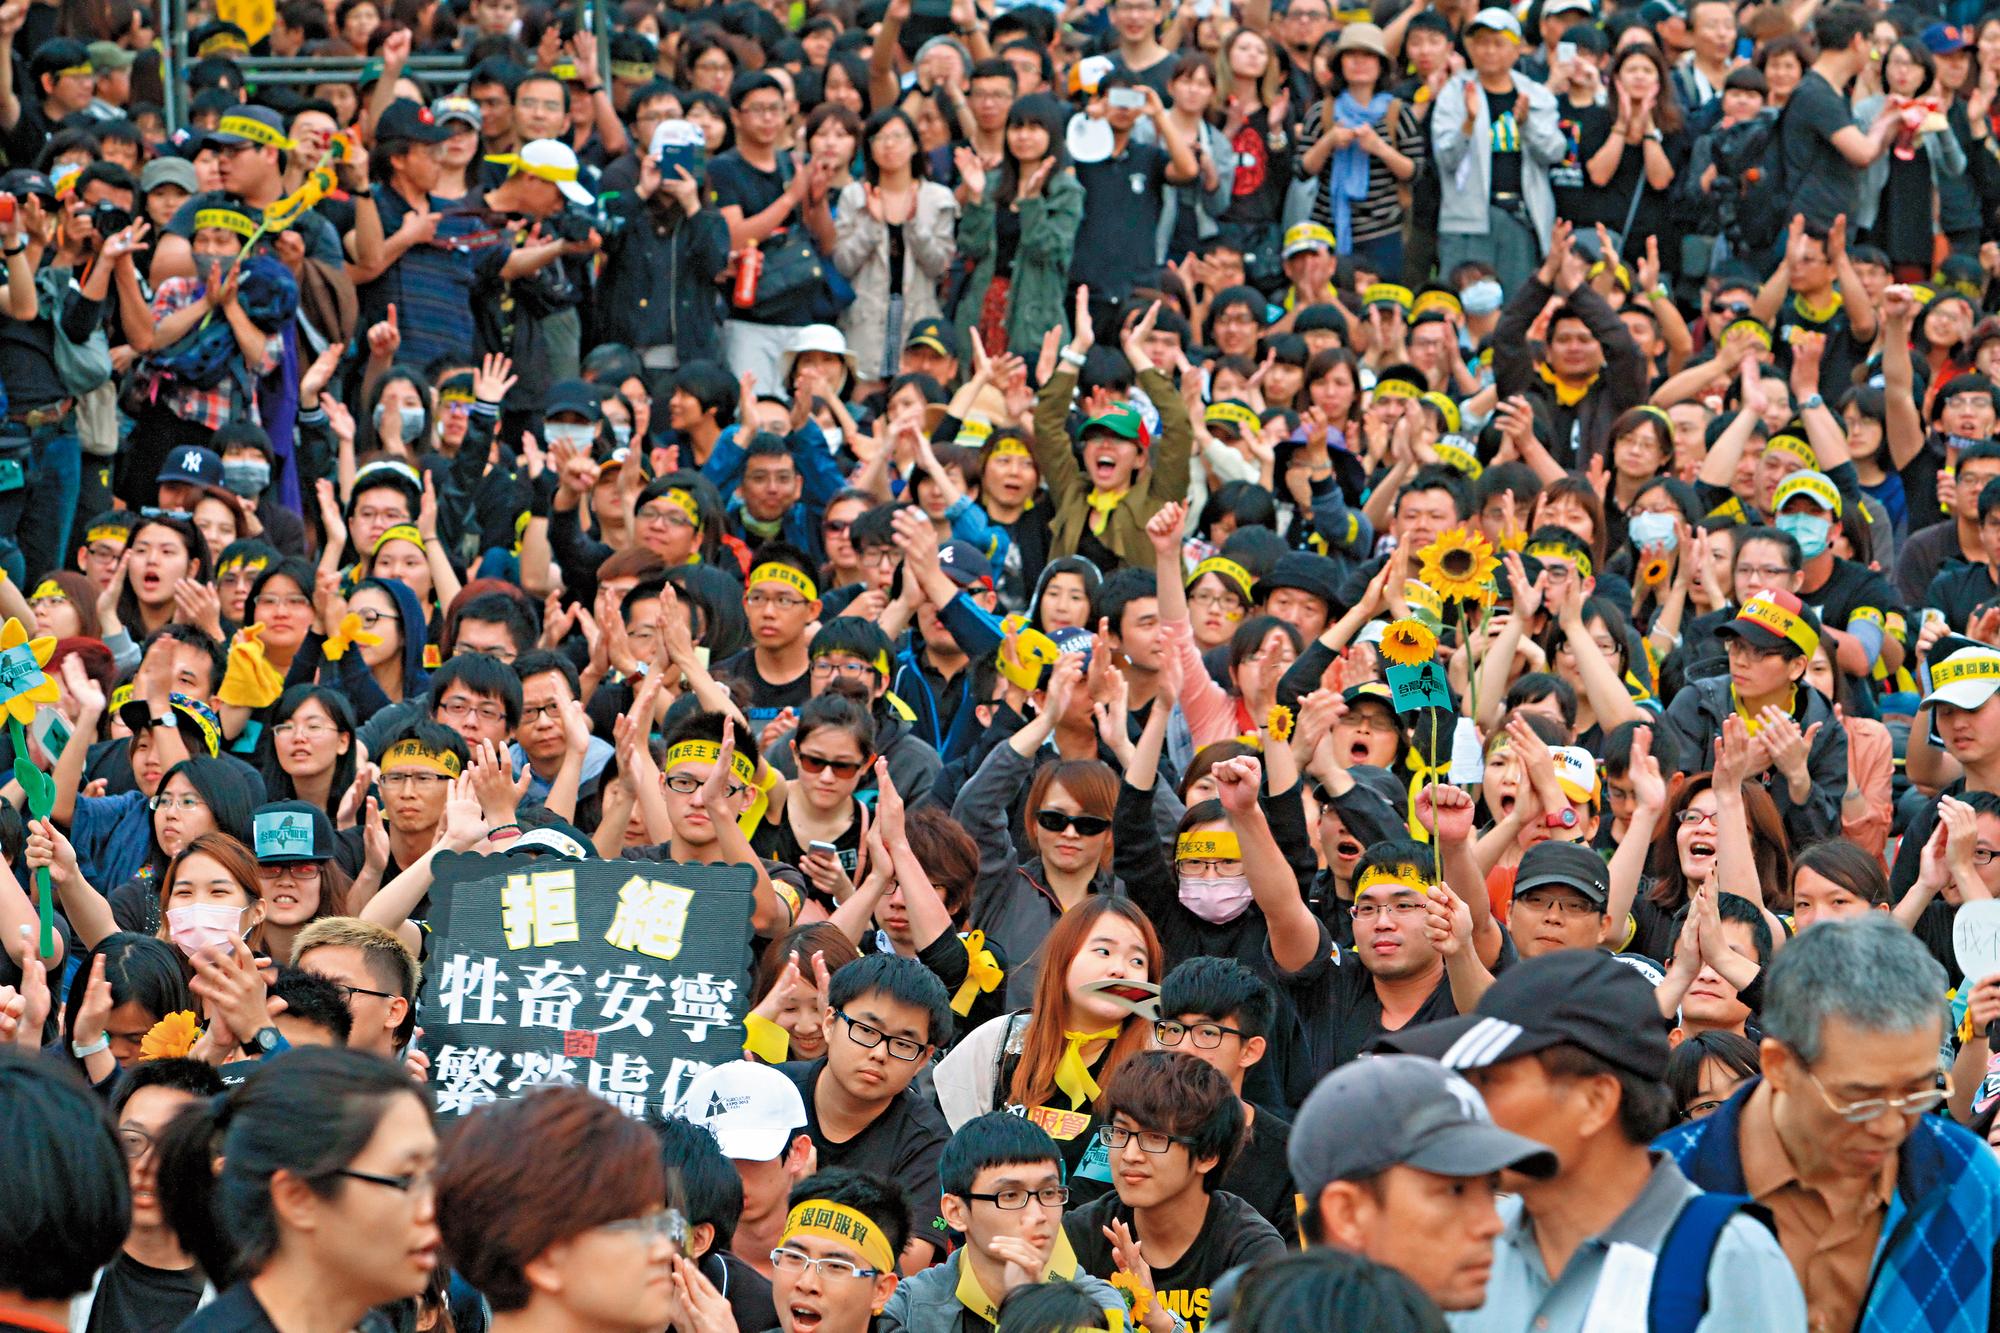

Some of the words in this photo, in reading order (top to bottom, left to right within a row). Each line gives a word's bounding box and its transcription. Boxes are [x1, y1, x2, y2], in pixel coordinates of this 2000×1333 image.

[183, 450, 203, 473] NY
[501, 869, 695, 961] 拒絕
[439, 954, 738, 1043] 牲畜安寧
[800, 1207, 869, 1246] 退回服貿
[1156, 1288, 1215, 1320] MUS
